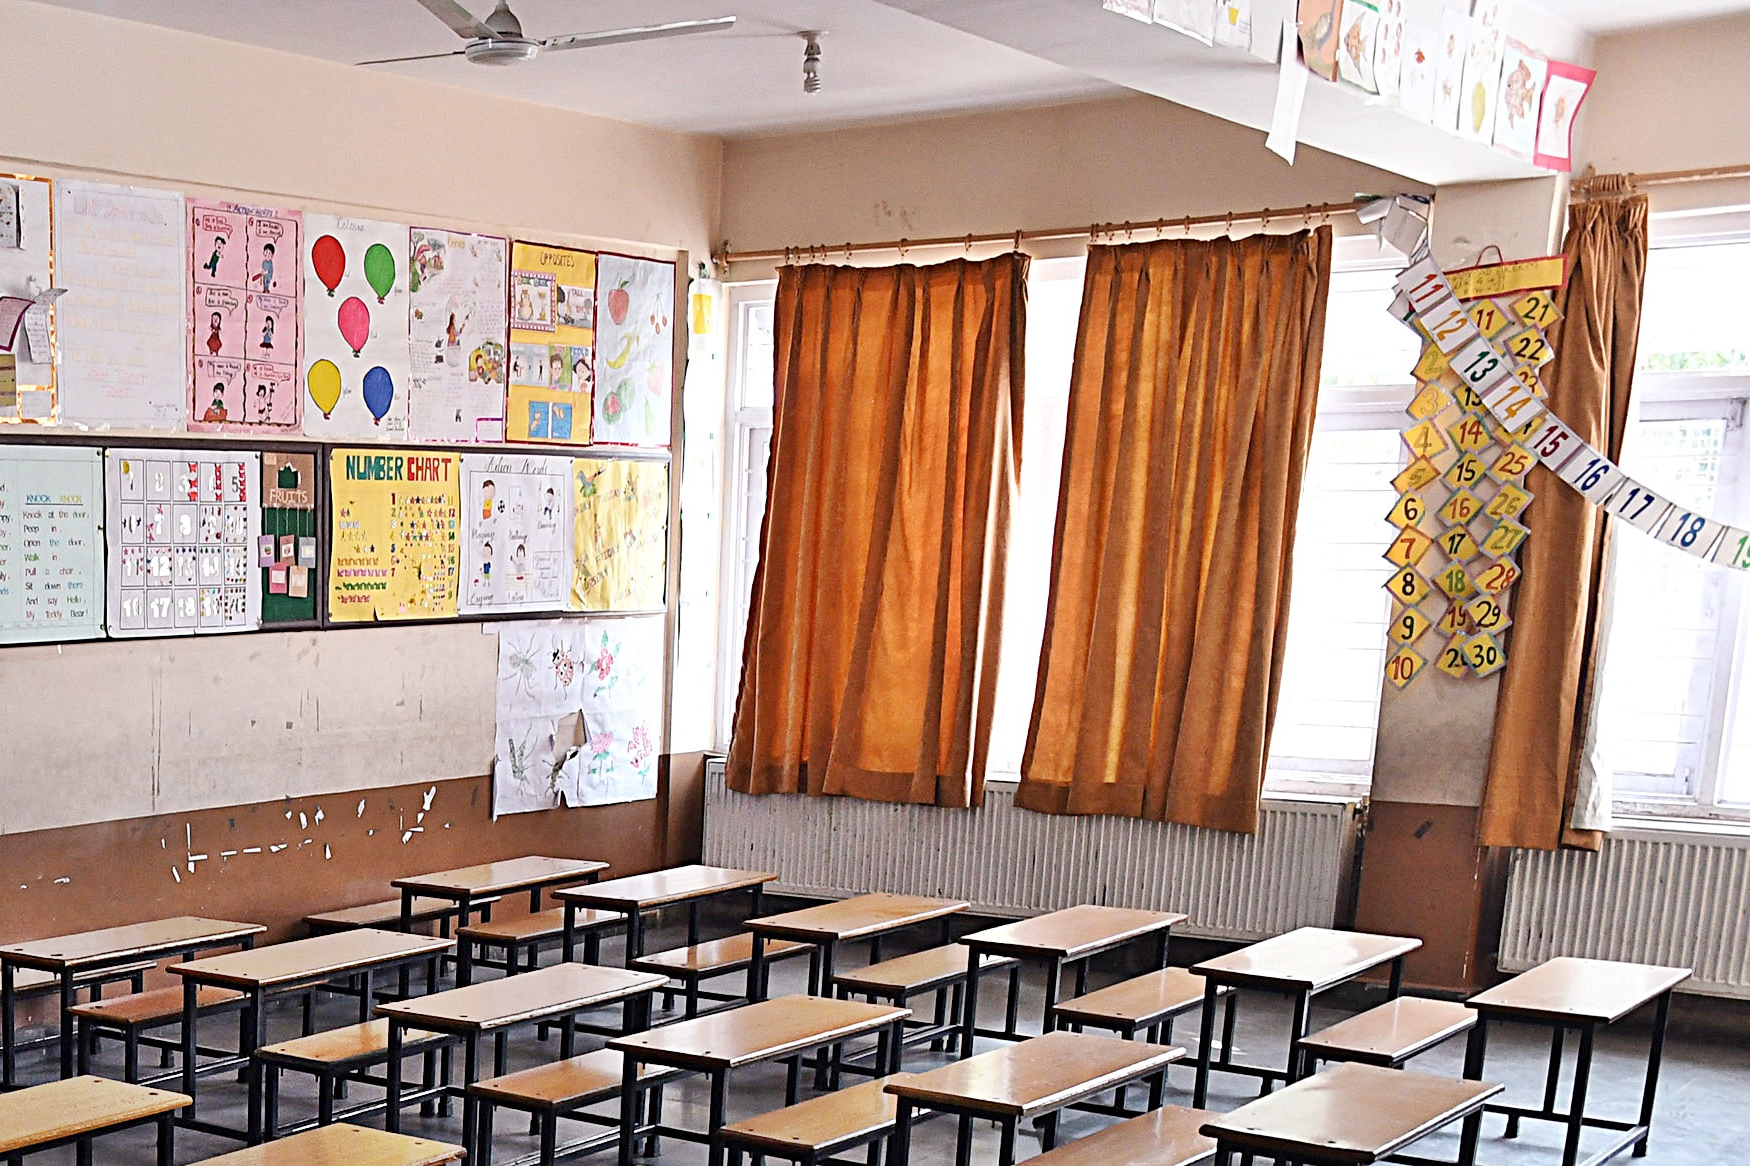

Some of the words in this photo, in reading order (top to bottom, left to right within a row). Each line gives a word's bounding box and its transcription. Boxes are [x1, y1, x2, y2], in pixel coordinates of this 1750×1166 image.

[1522, 297, 1549, 322] 21
[1515, 337, 1545, 360] 22
[1409, 273, 1444, 303] 11
[1432, 310, 1468, 341] 12
[1464, 351, 1499, 383] 13
[1492, 385, 1532, 420] 14
[1533, 425, 1569, 457] 15
[1574, 458, 1610, 491] 16
[1619, 488, 1655, 520] 17
[1671, 513, 1706, 547] 18
[1460, 421, 1482, 444] 14
[346, 455, 403, 481] NUMBER
[407, 456, 452, 481] CHART
[1457, 460, 1477, 482] 15
[1499, 452, 1528, 475] 25
[269, 489, 308, 504] FRUITS
[1404, 498, 1418, 521] 6
[1450, 498, 1470, 519] 16
[1401, 538, 1416, 559] 7
[1448, 534, 1466, 555] 17
[1402, 572, 1415, 596] 8
[1446, 570, 1465, 593] 18
[1486, 564, 1515, 590] 28
[1401, 616, 1414, 640] 9
[1476, 601, 1501, 628] 29
[1391, 656, 1413, 680] 10
[1472, 645, 1497, 668] 30
